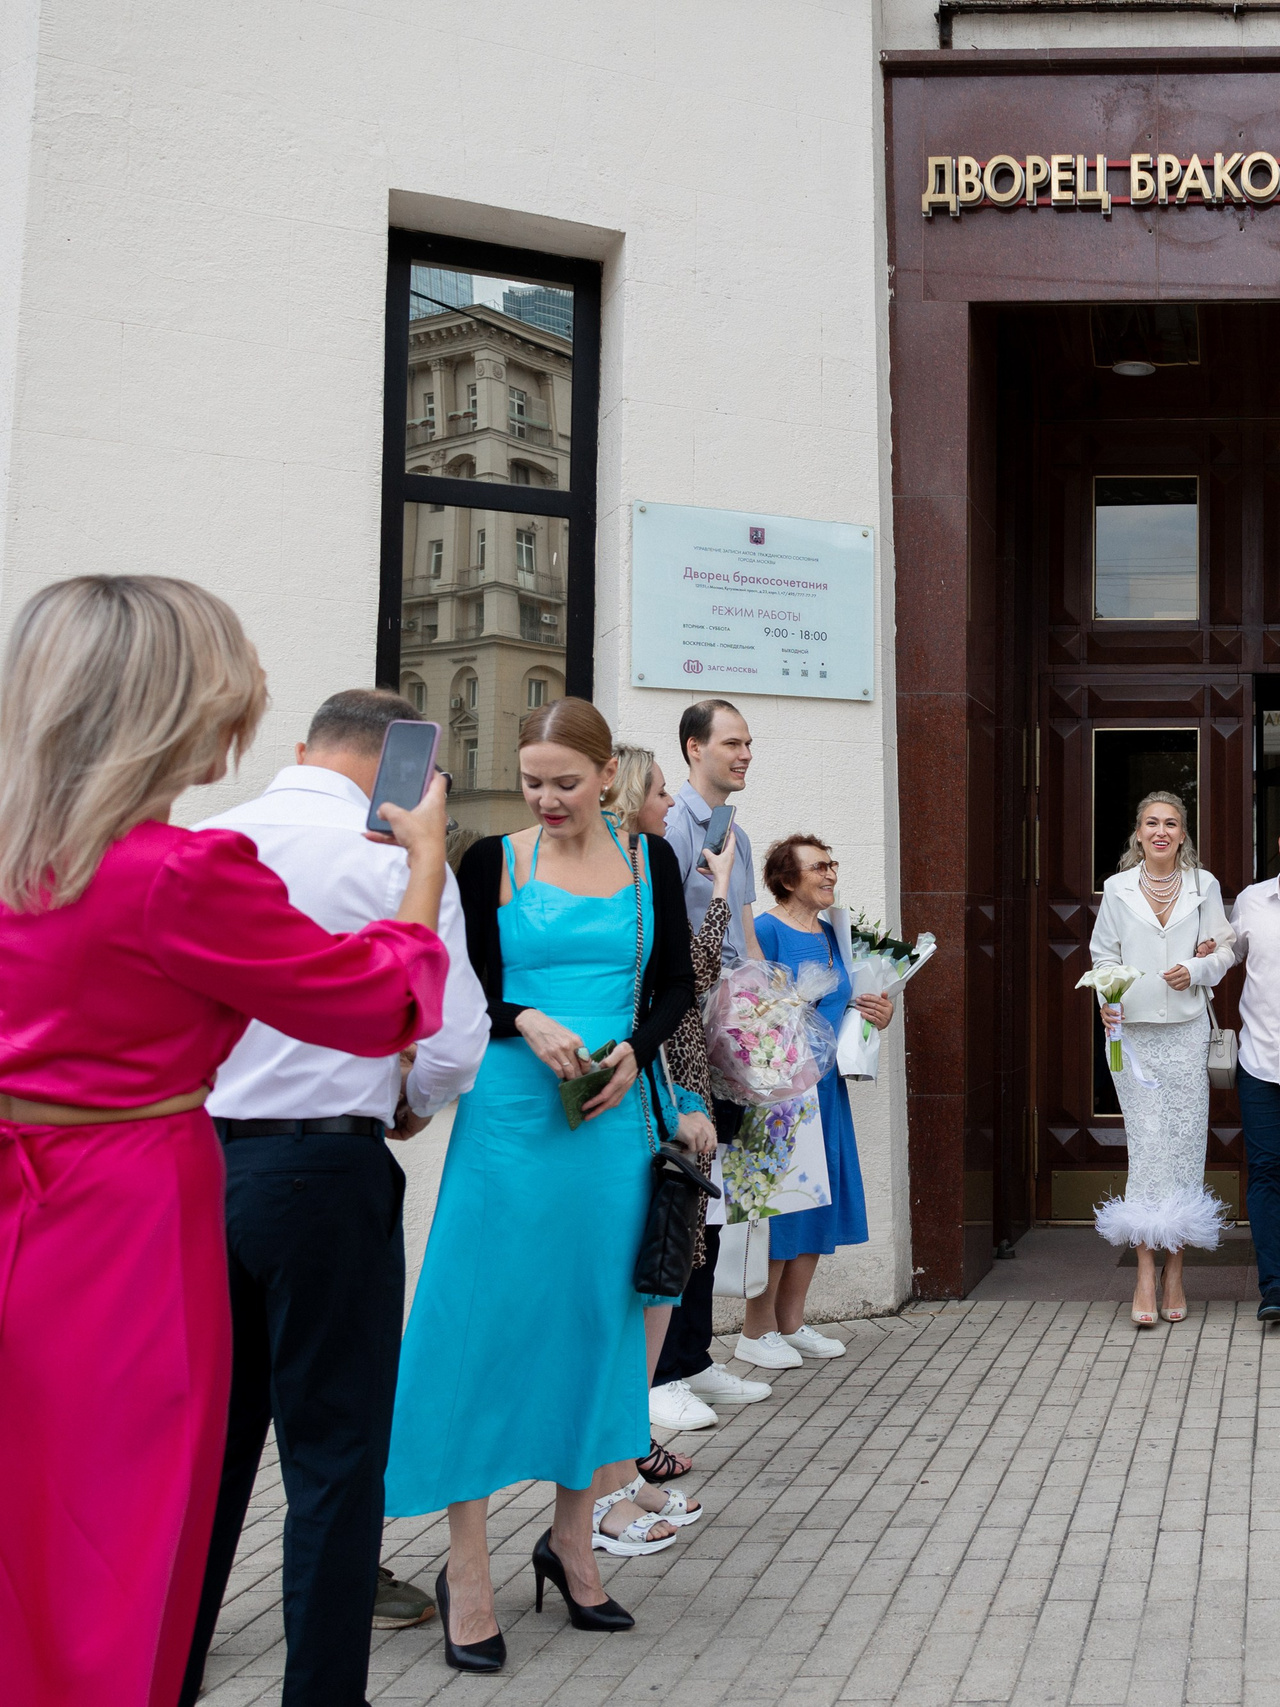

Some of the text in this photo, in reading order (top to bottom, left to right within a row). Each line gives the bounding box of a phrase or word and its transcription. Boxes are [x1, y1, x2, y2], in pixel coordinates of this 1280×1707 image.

[922, 154, 1112, 217] ДВОРЕЦ
[683, 567, 730, 583] Дворец
[733, 571, 828, 591] бракосочетания
[712, 605, 801, 622] РЕЖИМ РАБОТЫ
[764, 627, 788, 639] 9:00
[800, 629, 828, 642] 18:00
[707, 664, 758, 674] ЗАГС МОСКВЫ
